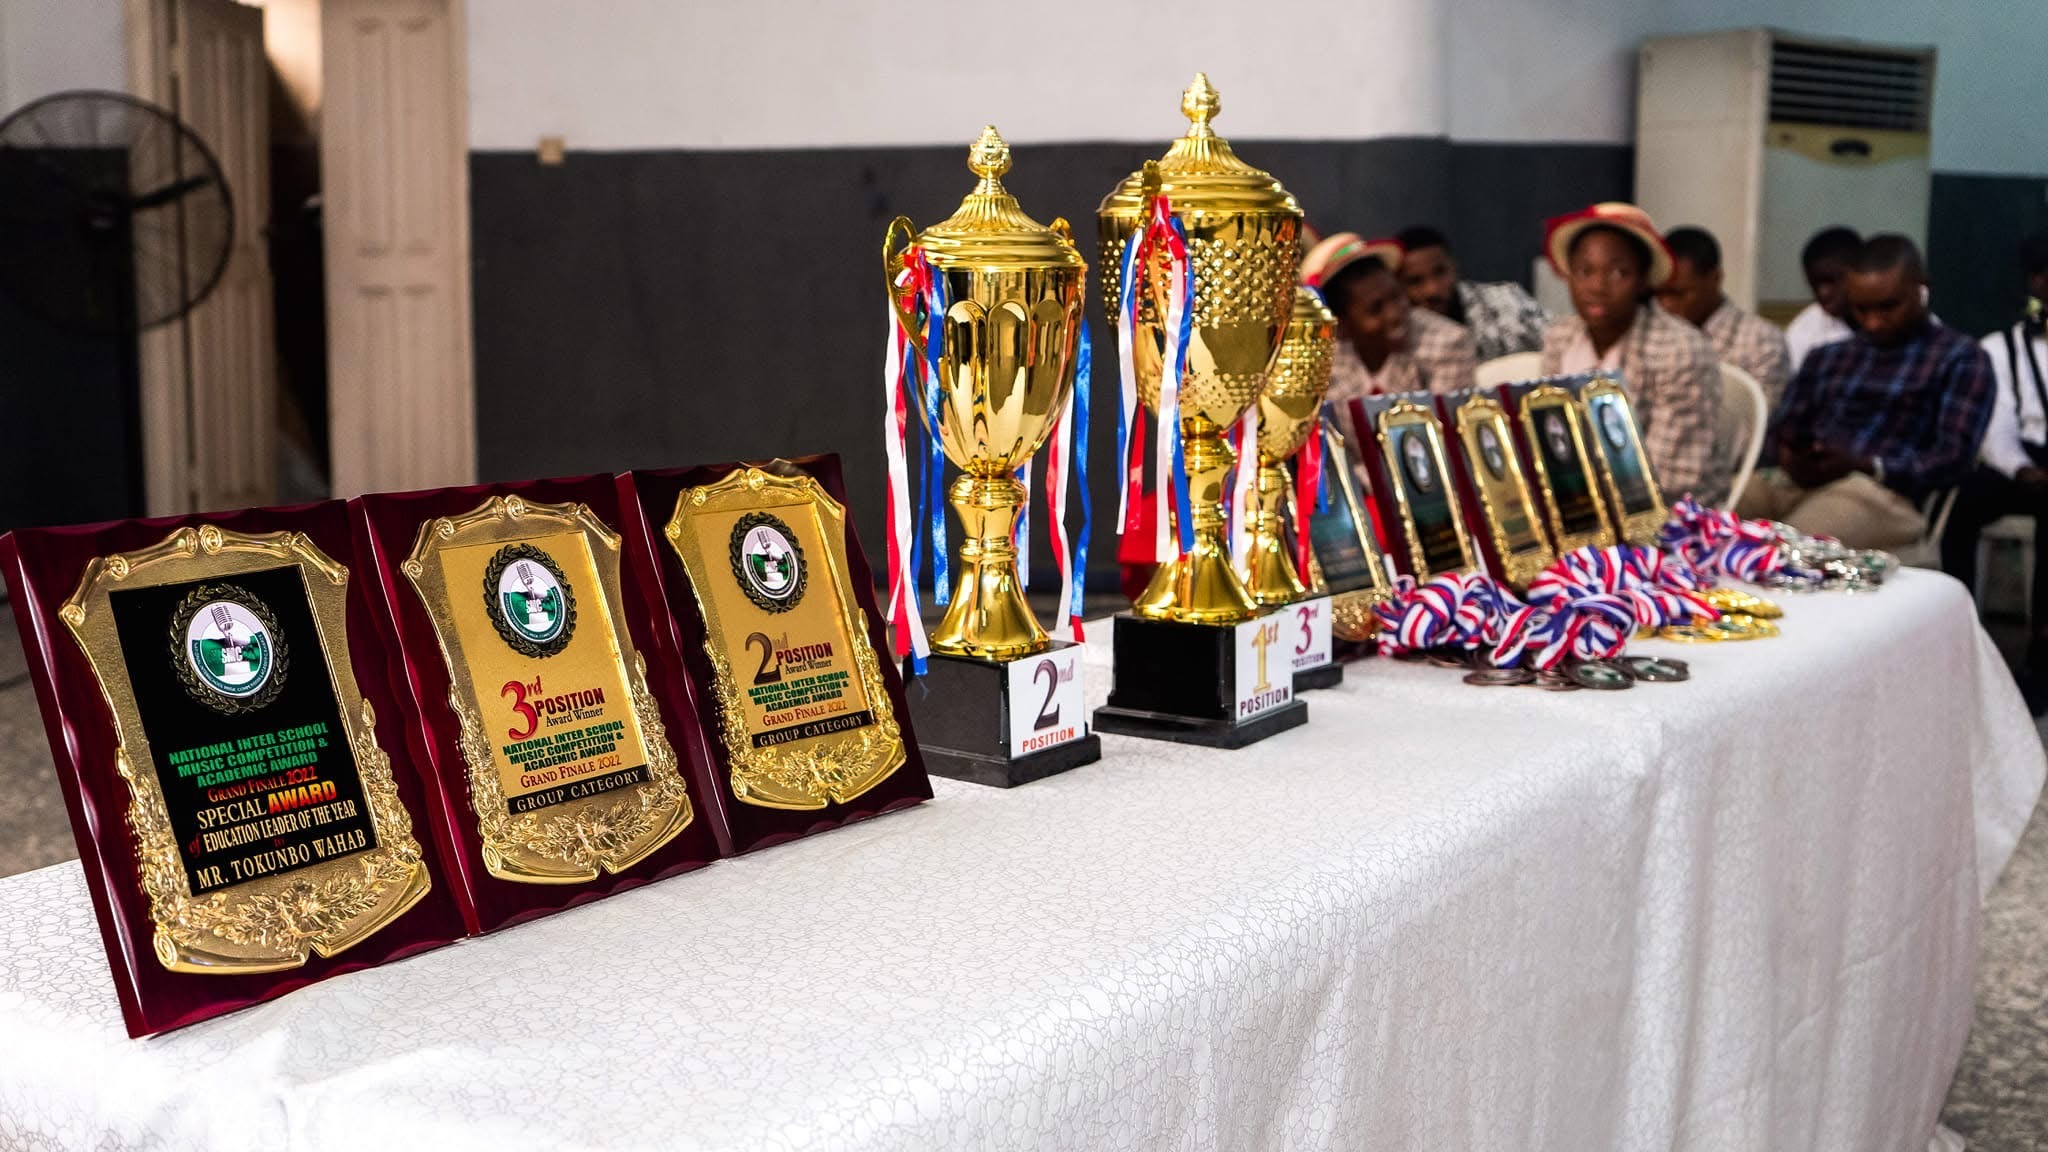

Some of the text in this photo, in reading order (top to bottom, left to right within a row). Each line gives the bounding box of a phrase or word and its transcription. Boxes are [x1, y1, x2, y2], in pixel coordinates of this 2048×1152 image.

[1295, 603, 1319, 655] 3rd
[745, 632, 833, 685] 2nd POSITION
[785, 660, 832, 674] Award Winner
[1252, 621, 1279, 693] 1st
[748, 671, 849, 697] NATIONAL INTER SCHOOL
[754, 693, 783, 705] MUSIC
[785, 683, 842, 698] COMPETITION
[765, 690, 842, 712] ACADEMIC AWARD
[1033, 659, 1073, 731] 2nd
[1240, 686, 1288, 716] POSITION
[501, 675, 606, 740] 3rd POSITION
[546, 707, 604, 727] Award Winner
[763, 713, 793, 726] GRAND
[794, 706, 824, 719] FINALE
[169, 722, 328, 765] NATIONAL INTER SCHOOL
[503, 720, 625, 756] NATIONAL INTER SCHOOL
[509, 732, 624, 765] MUSIC COMPETITION &
[760, 715, 863, 747] GROUP CATEGORY
[1023, 727, 1074, 752] POSITION
[178, 737, 328, 778] MUSIC COMPETITION &
[197, 752, 318, 788] ACADEMIC AWARD
[520, 755, 622, 788] GRAND FINALE 2022
[524, 743, 616, 772] ACADEMIC AWARD
[208, 765, 318, 803] GRAND FINALE 2022
[516, 770, 641, 812] GROUP CATEGORY
[197, 780, 337, 830] SPECIAL AWARD
[188, 800, 357, 858] of EDUCATION LEADER OF THE YEAR
[274, 836, 285, 848] to
[196, 829, 366, 888] MR. TOKUNBO WAHAB
